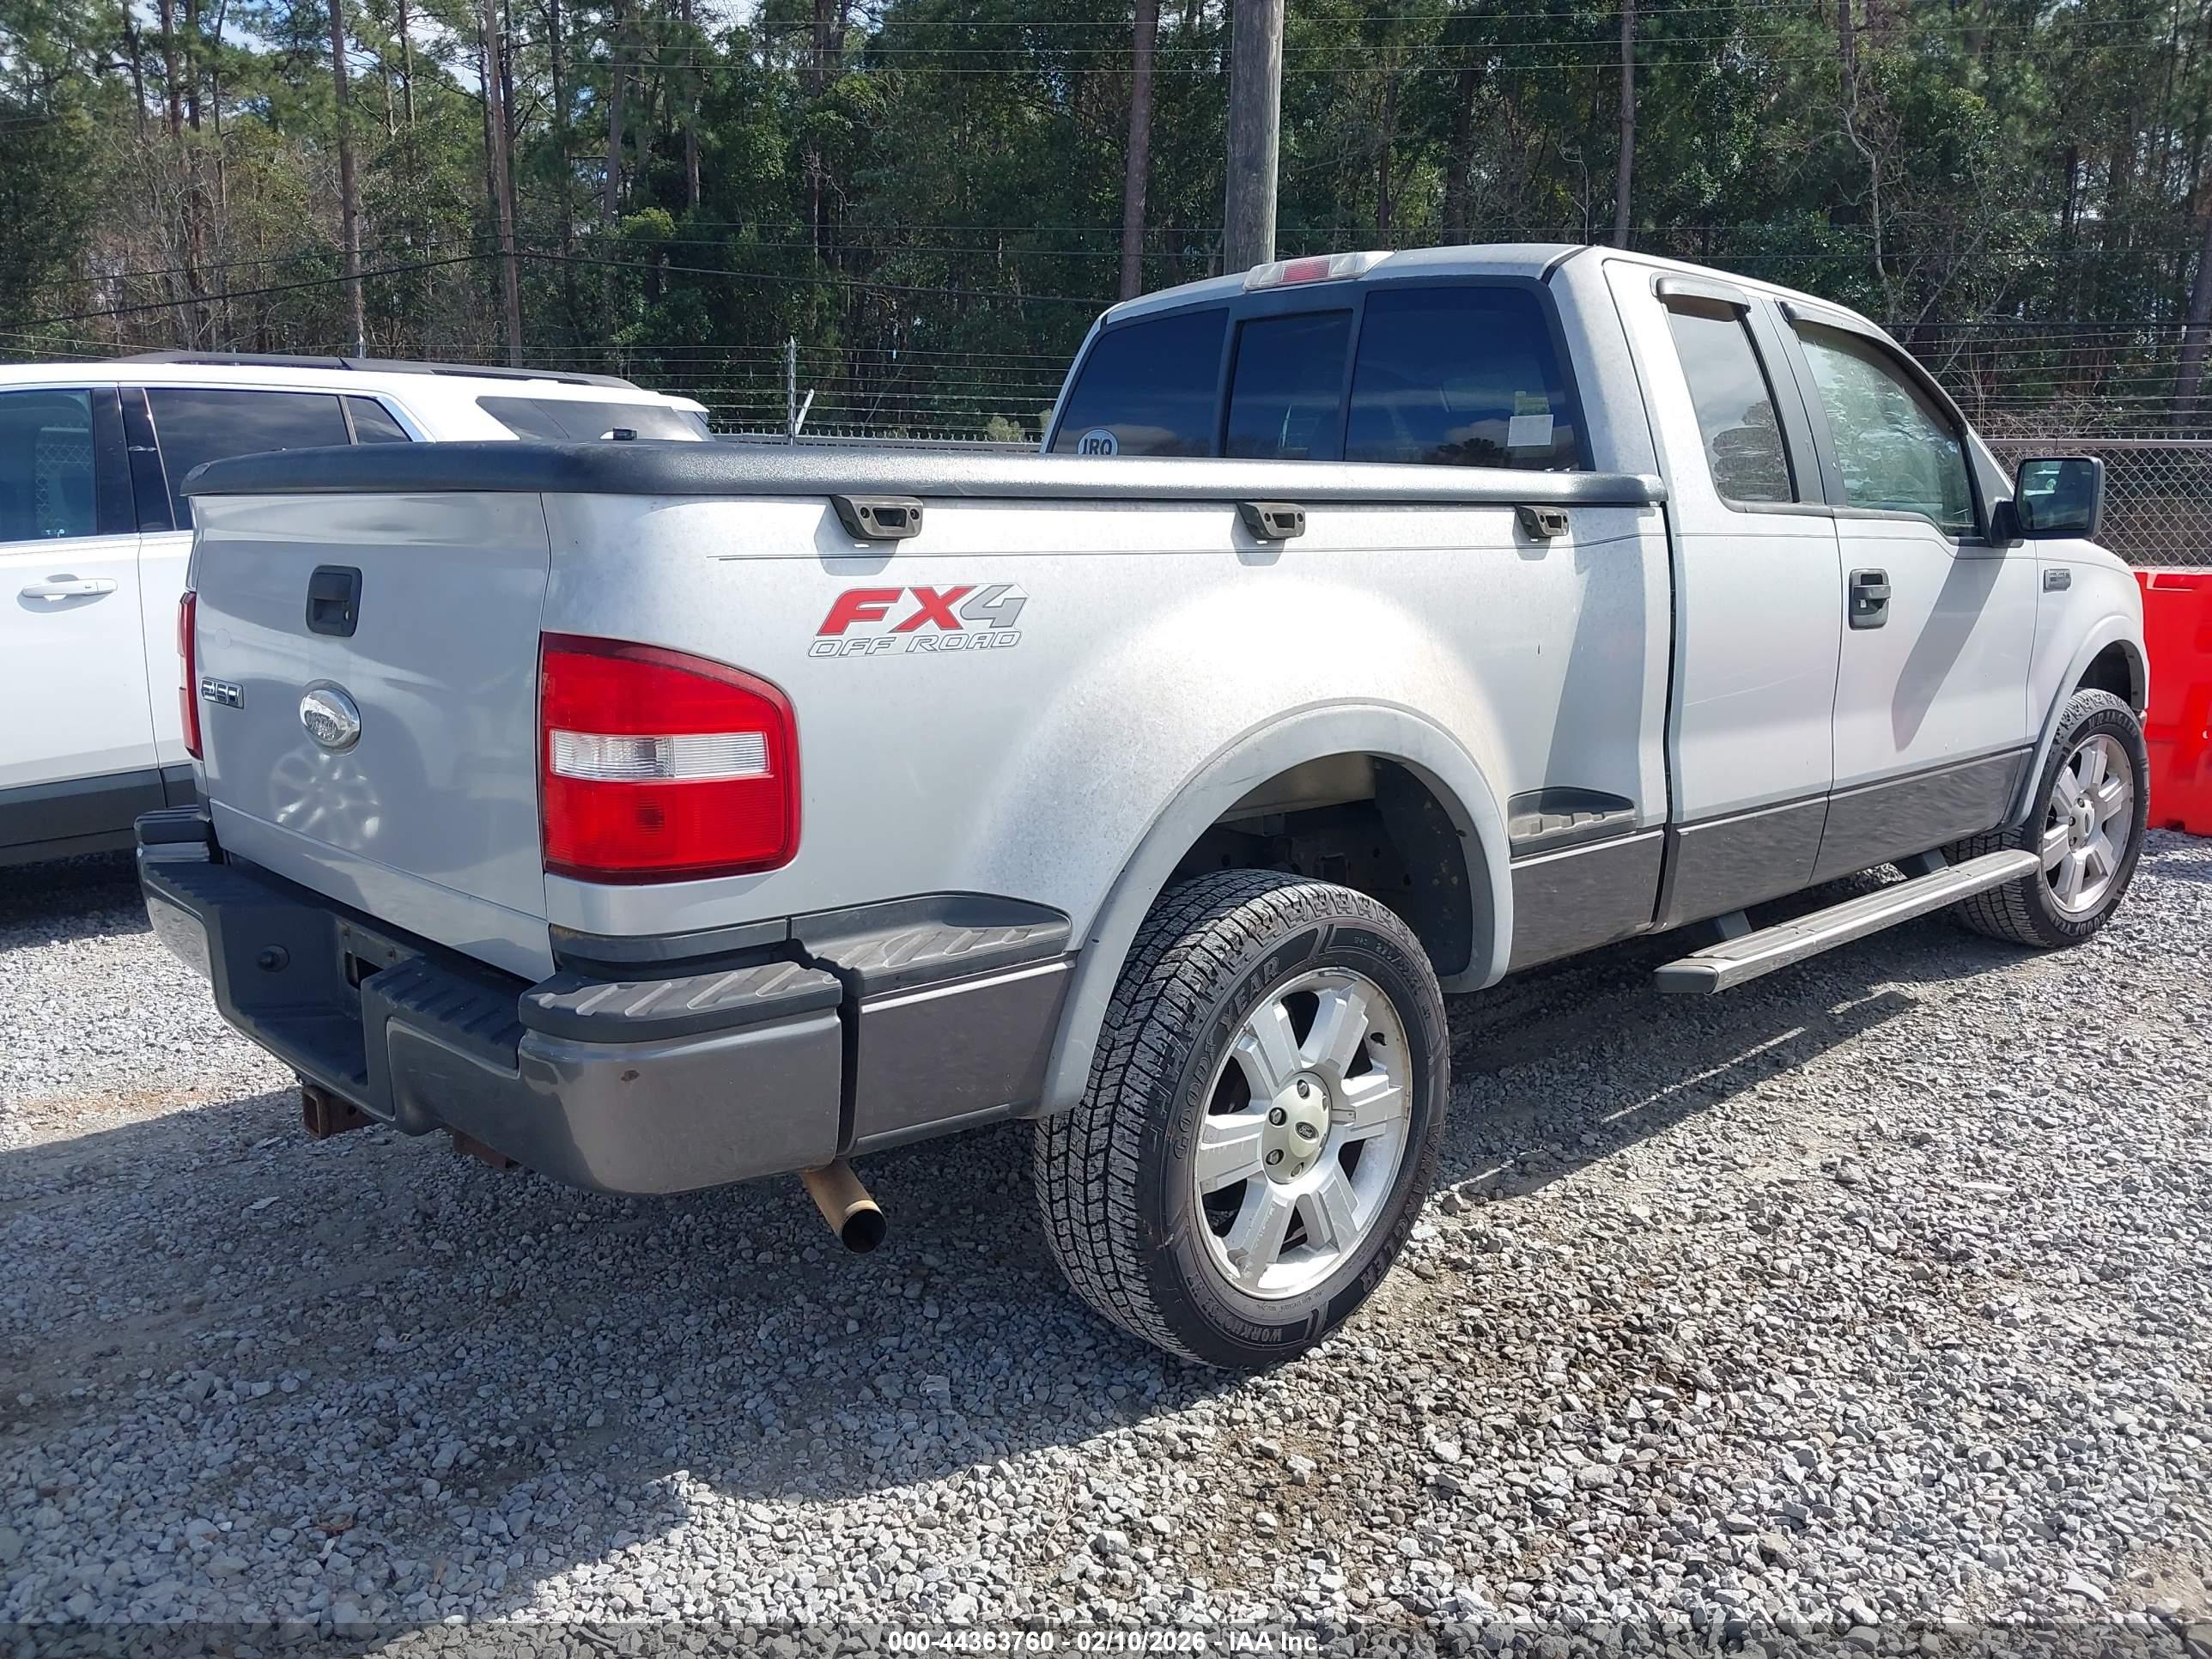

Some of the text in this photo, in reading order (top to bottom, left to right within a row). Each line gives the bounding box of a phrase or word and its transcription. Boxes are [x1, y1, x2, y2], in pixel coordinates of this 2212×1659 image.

[817, 585, 1027, 636] FX4
[808, 631, 1022, 658] OFF ROAD
[1360, 1122, 1443, 1292] WRANGLER
